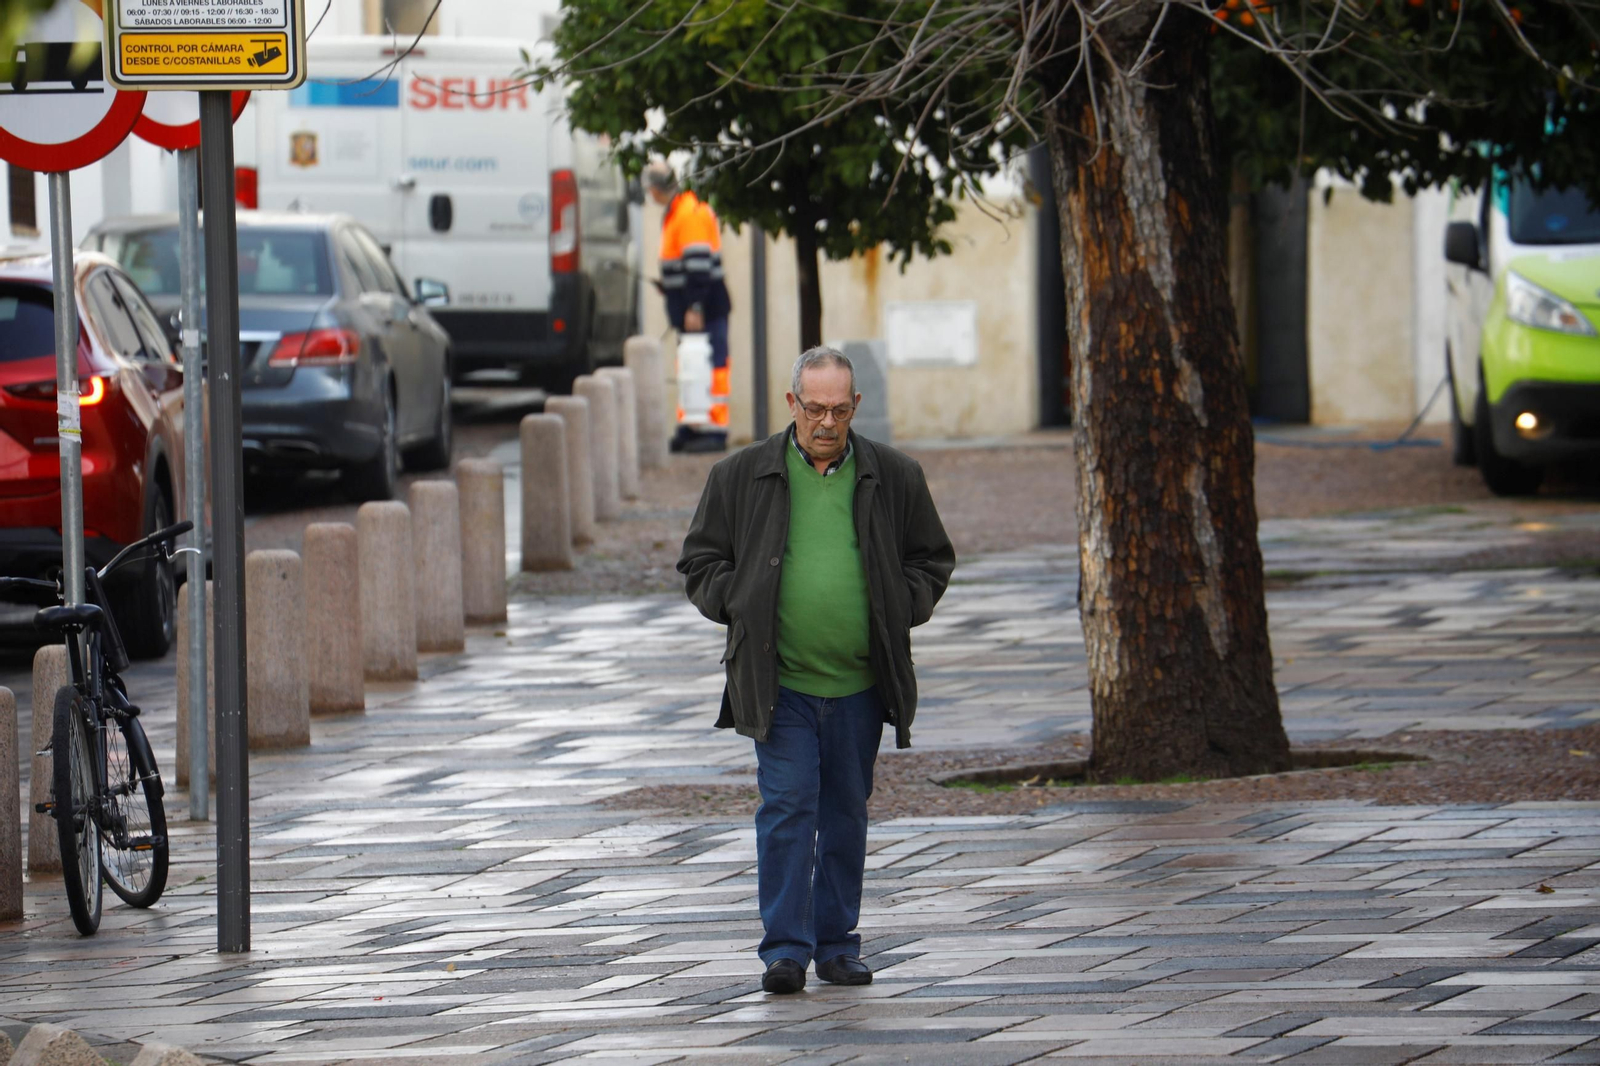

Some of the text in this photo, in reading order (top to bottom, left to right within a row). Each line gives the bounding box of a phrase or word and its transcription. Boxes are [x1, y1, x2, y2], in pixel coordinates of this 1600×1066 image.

[180, 8, 200, 16] 09:15
[134, 17, 172, 25] SÁBADOS
[125, 42, 244, 53] CONTROL POR CÁMARA
[126, 56, 241, 66] DESDE C/COSTANILLAS
[410, 77, 528, 110] SEUR
